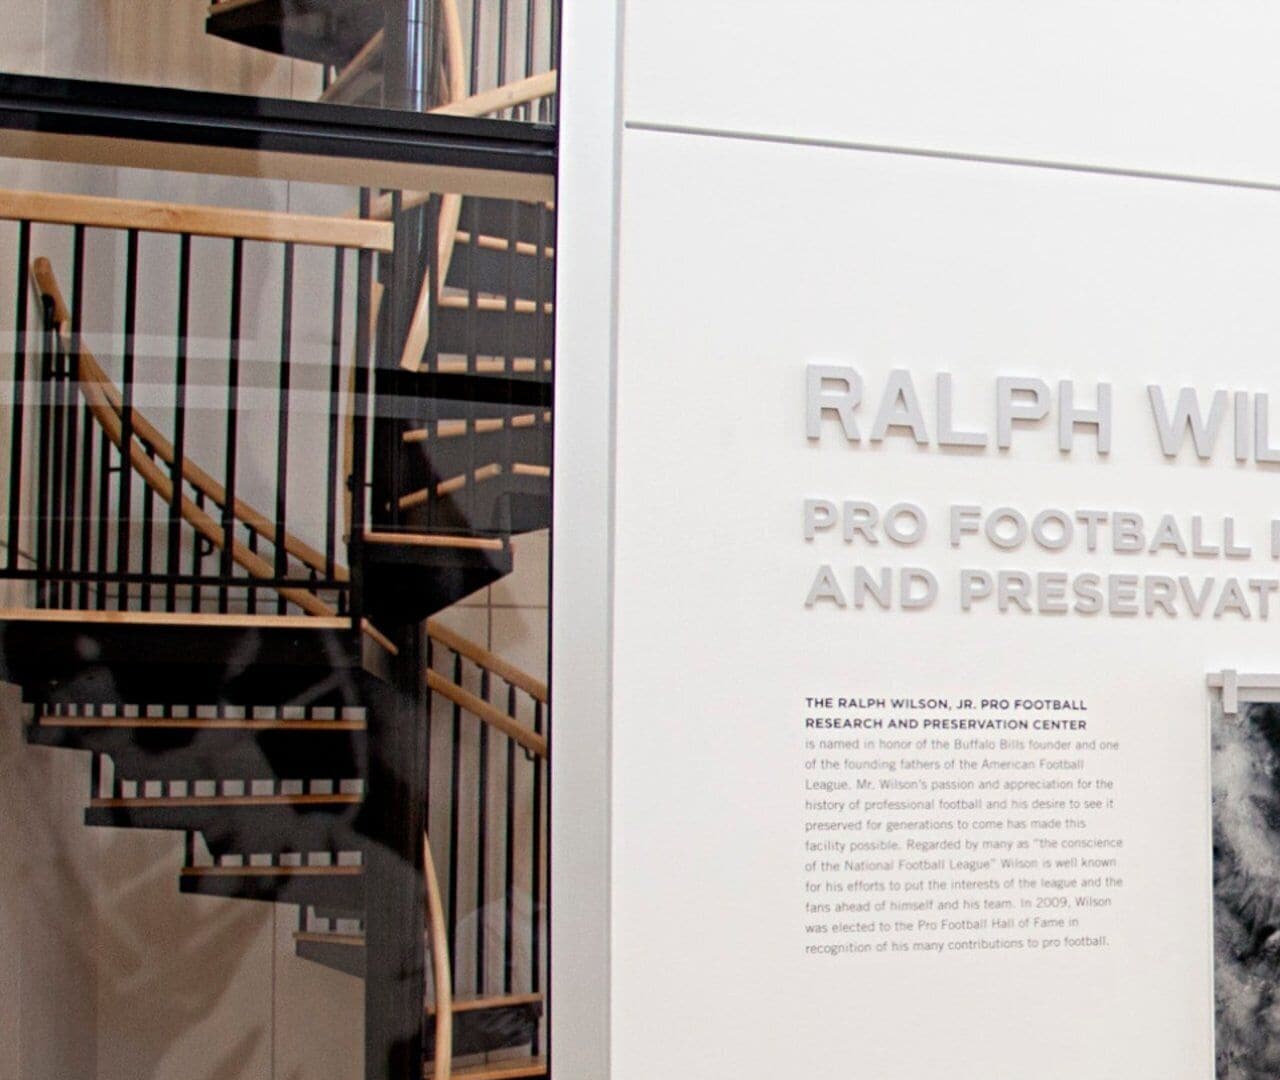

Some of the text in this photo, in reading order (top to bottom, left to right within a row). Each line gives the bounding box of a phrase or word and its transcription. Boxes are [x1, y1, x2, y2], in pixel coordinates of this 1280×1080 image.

[805, 364, 1112, 455] RALPH
[803, 499, 928, 546] PRO
[949, 504, 1251, 559] FOOTBALL
[805, 565, 939, 611] AND
[805, 697, 1087, 711] THE RALPH WILSON, JR. PRO FOOTBALL
[805, 718, 1086, 730] RESEARCH AND PRESERVATION CENTER
[805, 738, 1120, 750] is named in honor of the Buffalo Bills founder and one
[805, 758, 1084, 772] of the founding fathers of the American Football
[931, 781, 974, 791] passion
[978, 779, 1000, 790] and
[1003, 779, 1073, 792] appreciation
[1077, 778, 1092, 789] for
[1096, 779, 1114, 790] the
[805, 798, 1114, 812] history of professional football and his desire to see it
[805, 819, 1086, 833] preserved for generations to come has made this
[805, 840, 846, 853] facility
[906, 839, 961, 852] Regarded
[965, 839, 978, 852] by
[983, 841, 1014, 852] many
[1017, 840, 1030, 848] as
[1061, 839, 1123, 848] conscience
[805, 860, 816, 872] of
[821, 861, 840, 872] the
[845, 860, 894, 872] National
[898, 859, 945, 870] Football
[1000, 858, 1038, 869] Wilson
[1042, 858, 1052, 869] is
[1055, 857, 1077, 868] well
[1081, 857, 1116, 868] known
[805, 876, 1123, 892] for his efforts to put the interests of the league and the
[805, 902, 831, 913] fans
[834, 901, 871, 912] ahead
[874, 900, 886, 912] of
[890, 899, 933, 911] himself
[937, 900, 959, 912] and
[963, 899, 980, 910] his
[1021, 899, 1032, 908] In
[1075, 896, 1112, 907] Wilson
[805, 917, 1079, 934] was elected to the Pro Football Hall of Fame in
[805, 942, 872, 956] recognition
[875, 941, 888, 952] of
[891, 941, 909, 951] his
[913, 942, 944, 952] many
[947, 938, 1024, 951] contributions
[1027, 939, 1039, 948] to
[1042, 939, 1061, 949] pro
